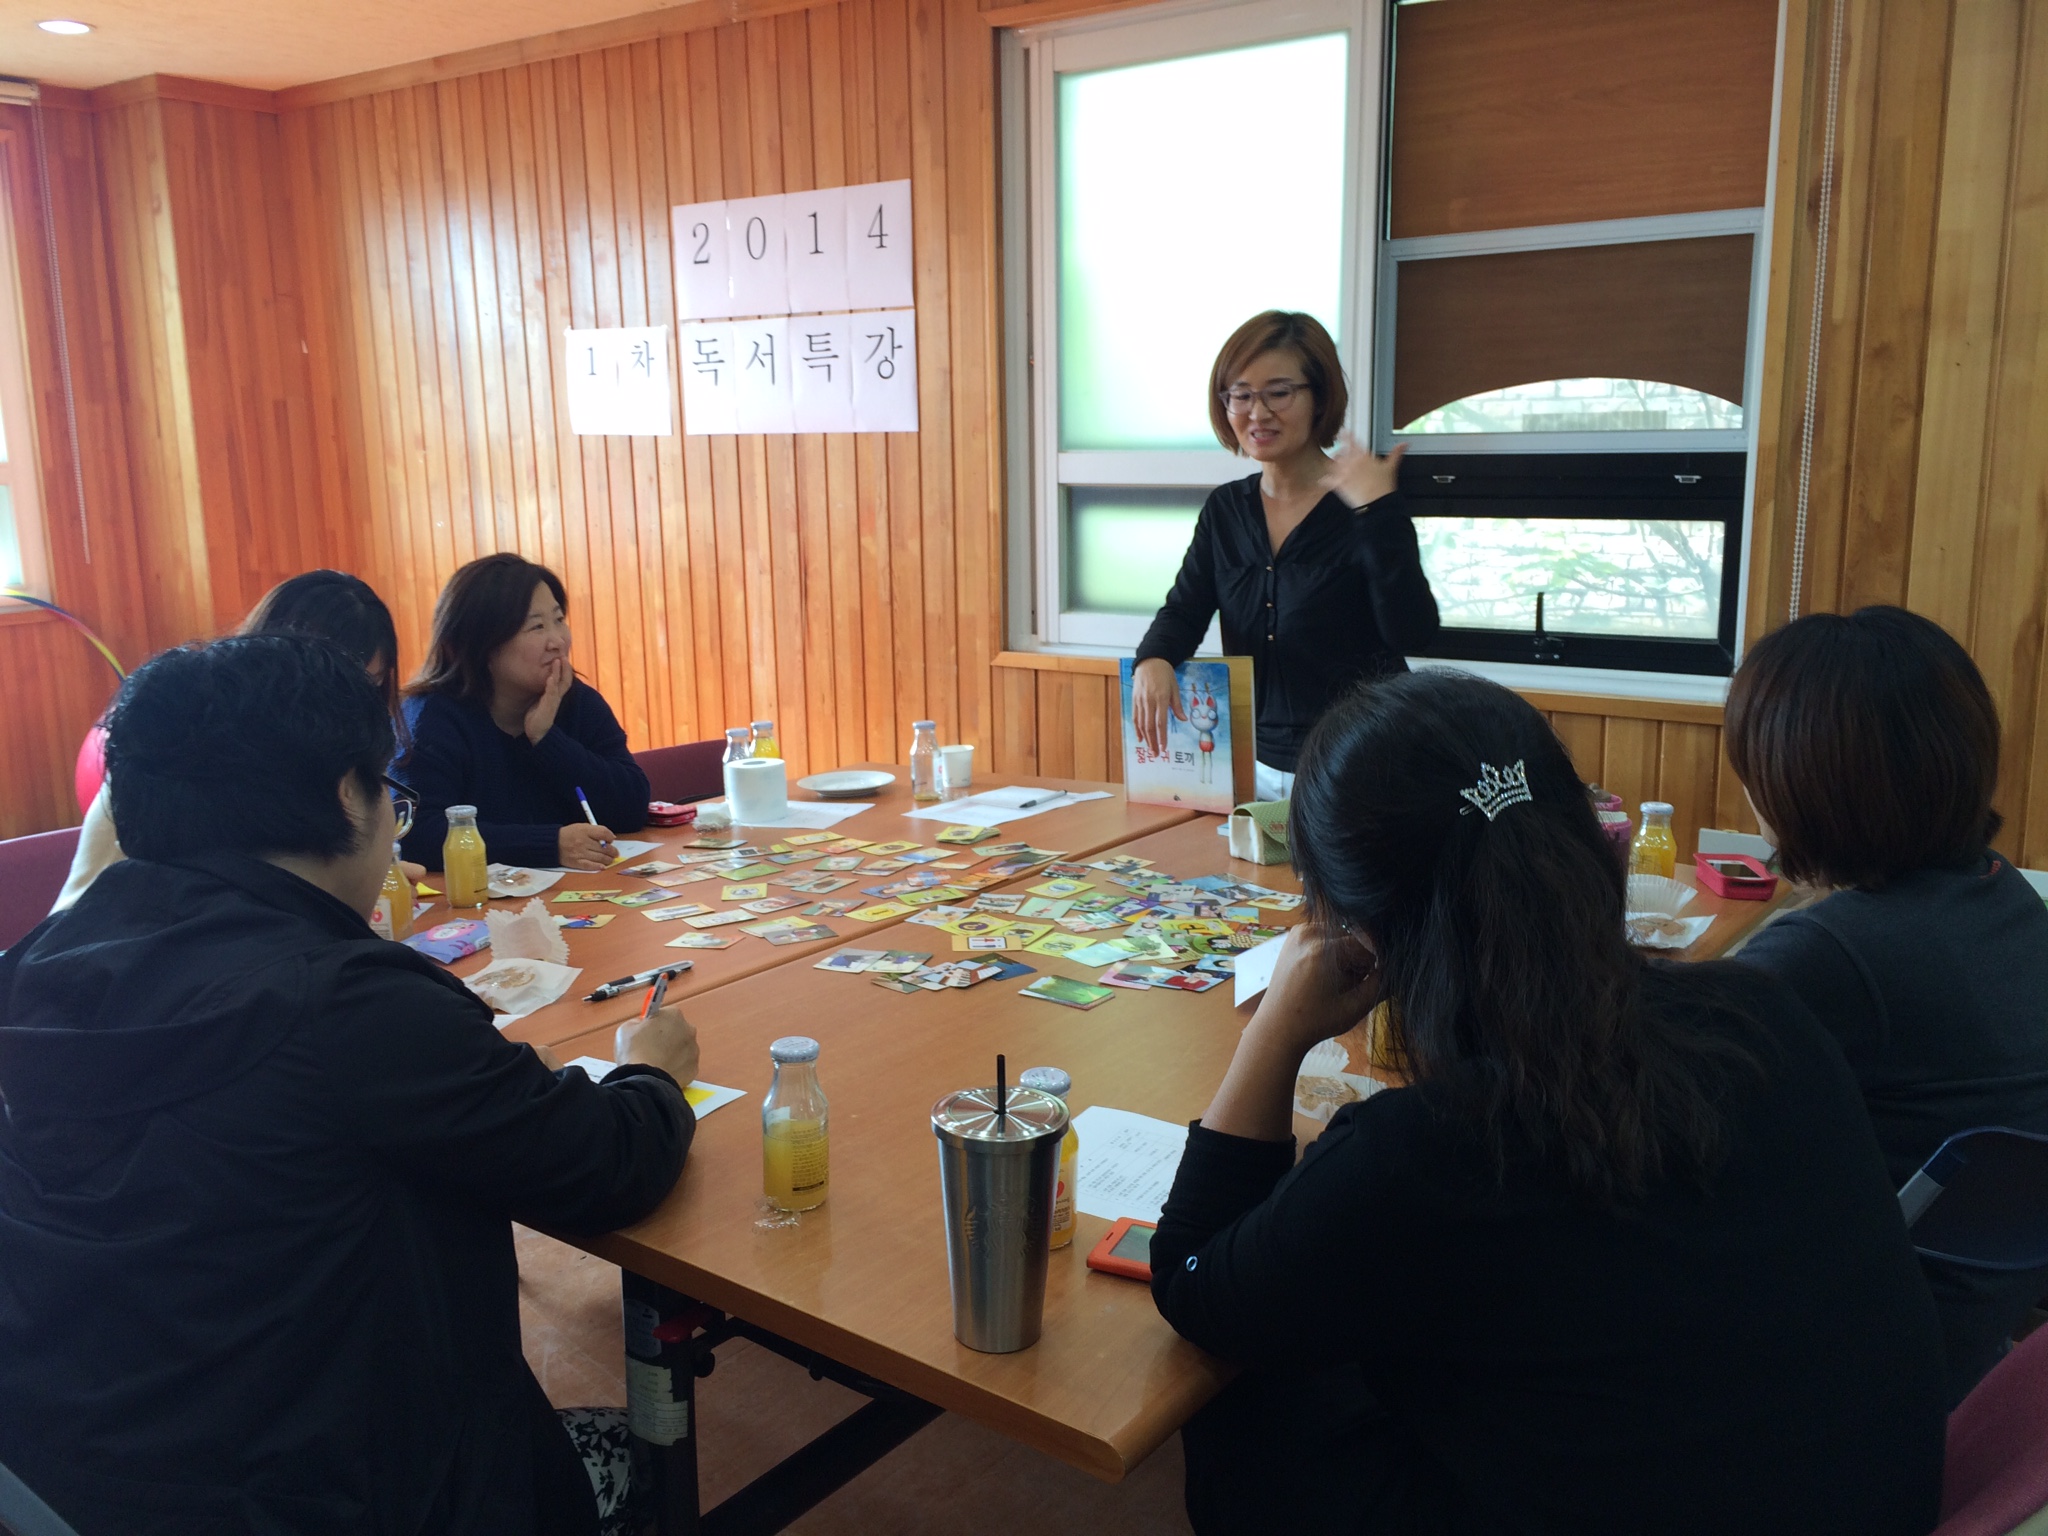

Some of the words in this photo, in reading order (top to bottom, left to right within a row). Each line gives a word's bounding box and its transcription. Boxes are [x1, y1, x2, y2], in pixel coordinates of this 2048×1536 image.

[692, 204, 888, 265] 2014
[587, 340, 655, 378] 1차
[692, 326, 903, 386] 독서특강
[1174, 751, 1195, 766] 토끼
